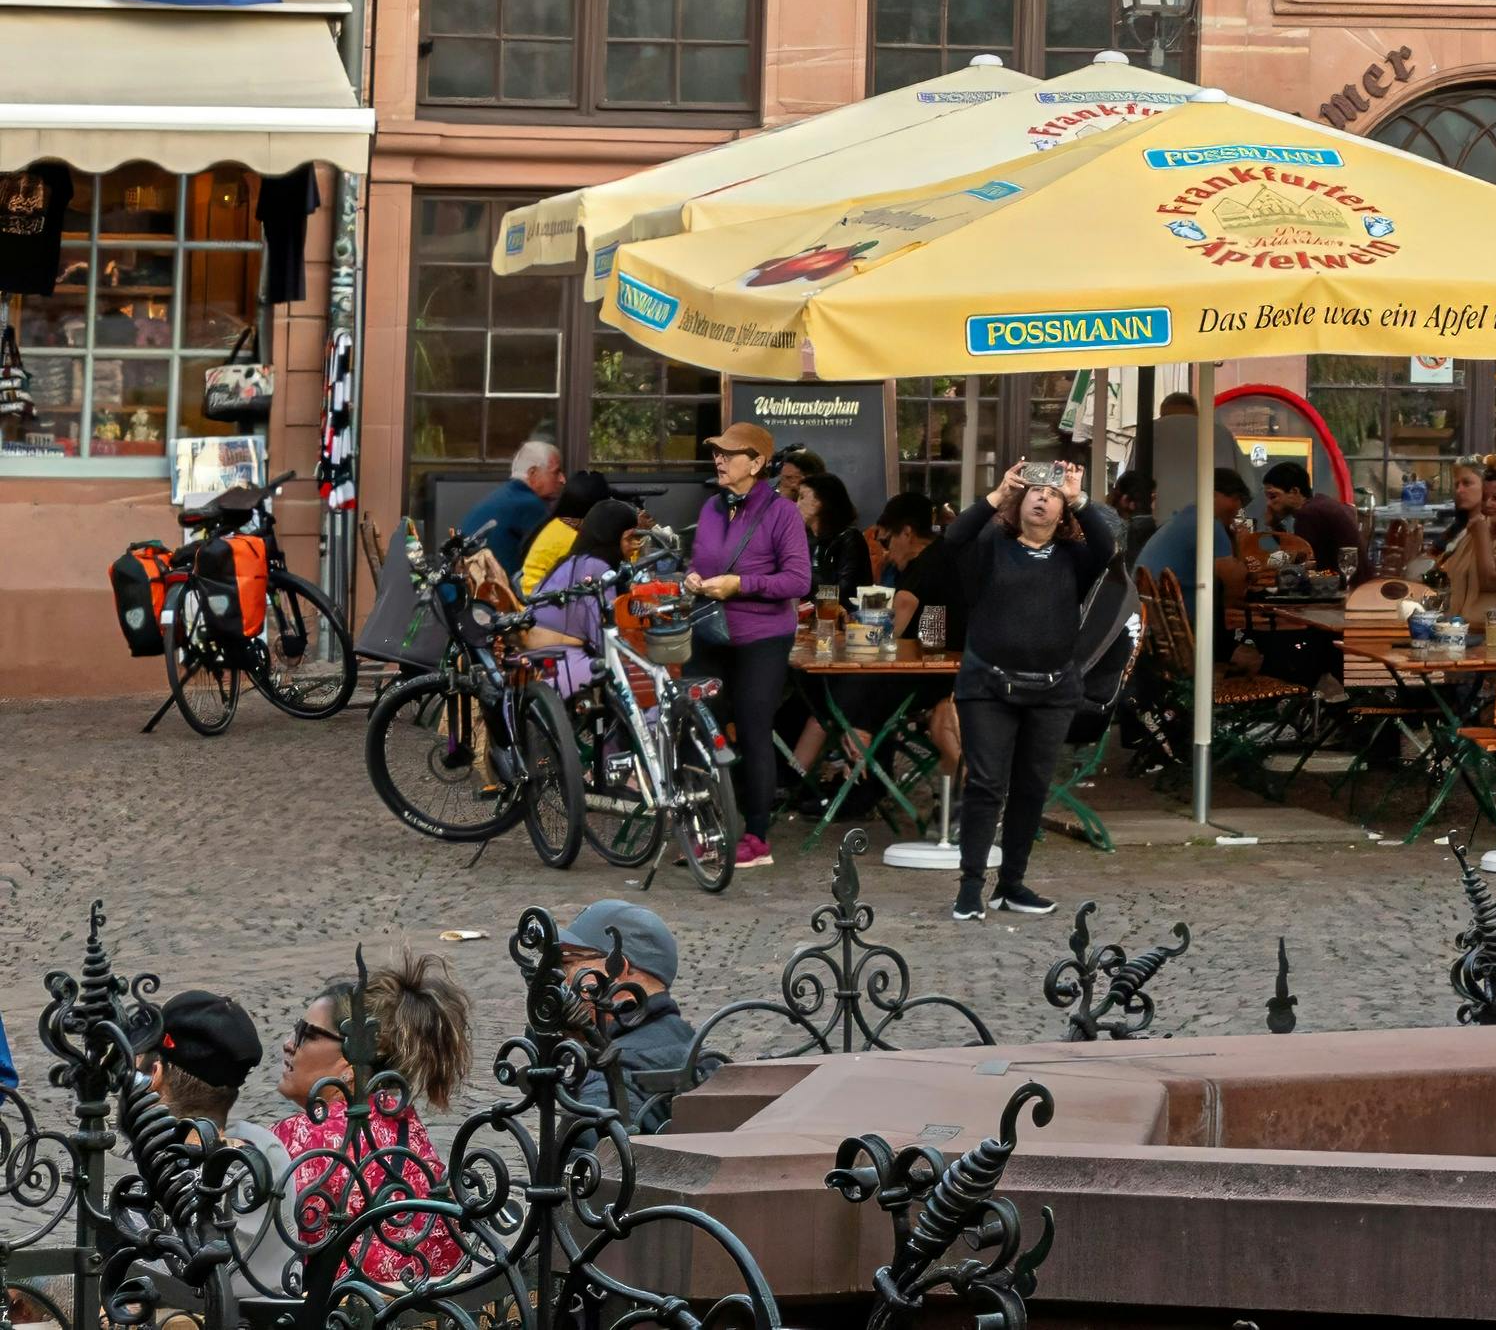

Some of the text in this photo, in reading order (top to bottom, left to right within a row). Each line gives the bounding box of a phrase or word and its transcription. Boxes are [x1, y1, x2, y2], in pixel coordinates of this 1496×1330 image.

[1156, 166, 1381, 215] Frankfurter
[987, 316, 1153, 346] POSSMANN
[1198, 308, 1247, 332] Das
[1255, 302, 1316, 330] Beste
[1323, 305, 1372, 326] was
[1380, 303, 1417, 327] ein
[1424, 304, 1488, 336] Apfel
[754, 396, 859, 418] Weihenstephan
